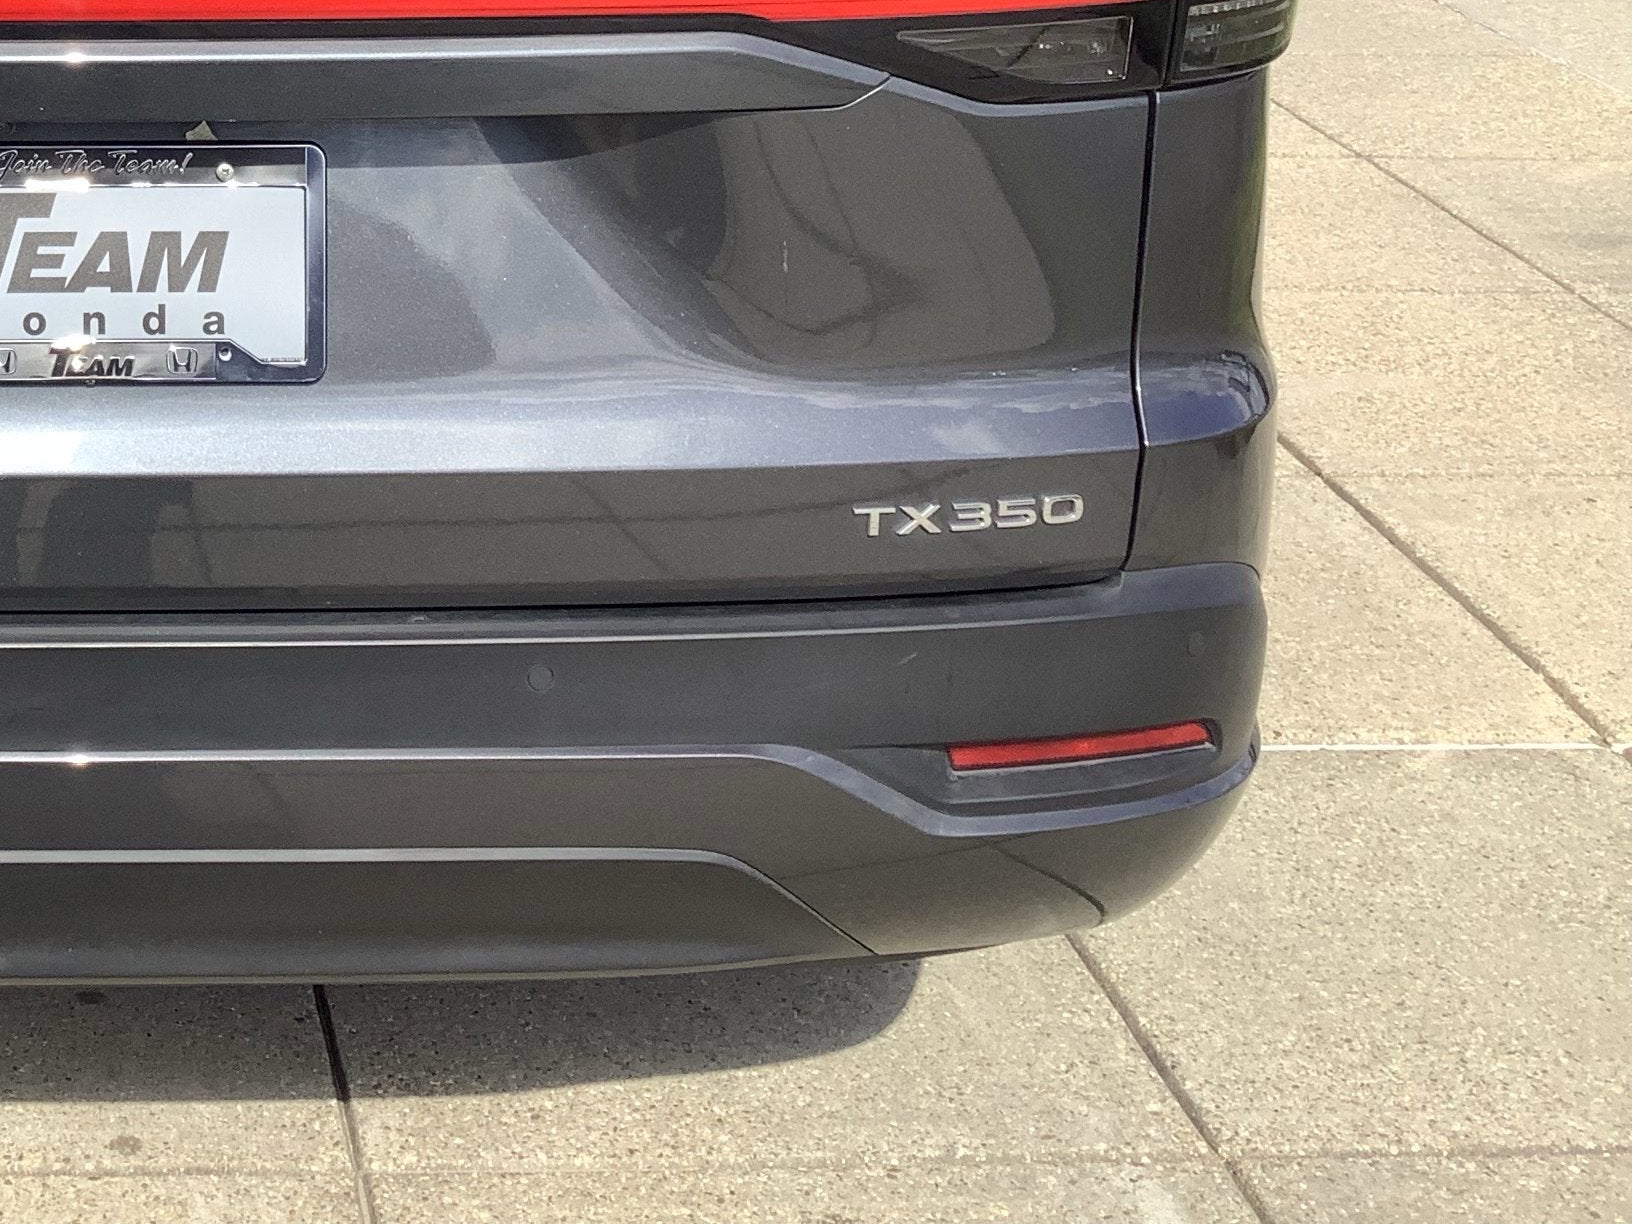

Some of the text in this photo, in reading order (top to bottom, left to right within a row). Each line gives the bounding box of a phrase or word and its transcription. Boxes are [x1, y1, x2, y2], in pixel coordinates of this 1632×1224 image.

[54, 149, 106, 175] The
[107, 149, 194, 176] Team!
[48, 344, 136, 377] TEAM
